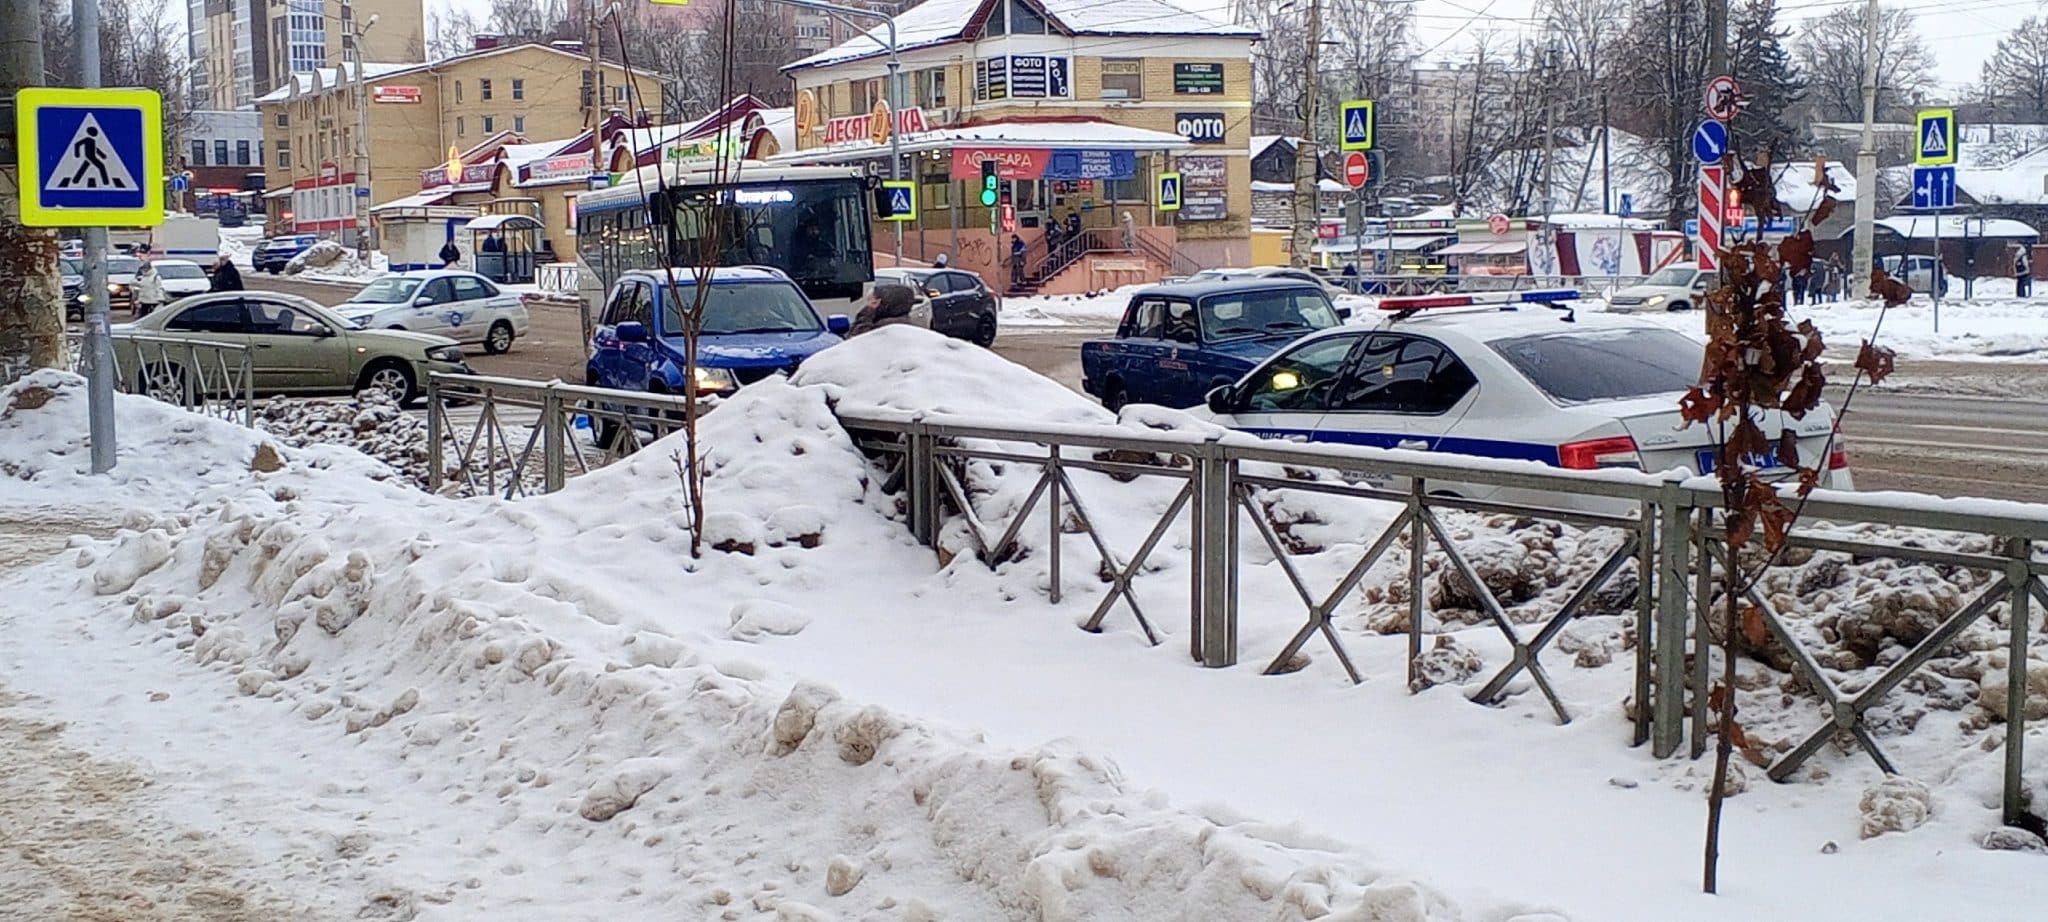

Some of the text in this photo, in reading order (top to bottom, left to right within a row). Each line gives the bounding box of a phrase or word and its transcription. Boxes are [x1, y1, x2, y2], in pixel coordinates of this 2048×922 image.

[1014, 58, 1043, 68] ФОТО
[1050, 59, 1068, 96] ФОТО
[1177, 118, 1224, 138] ФОТО
[962, 150, 1033, 168] ЛОМБАРД
[1726, 208, 1744, 227] 44
